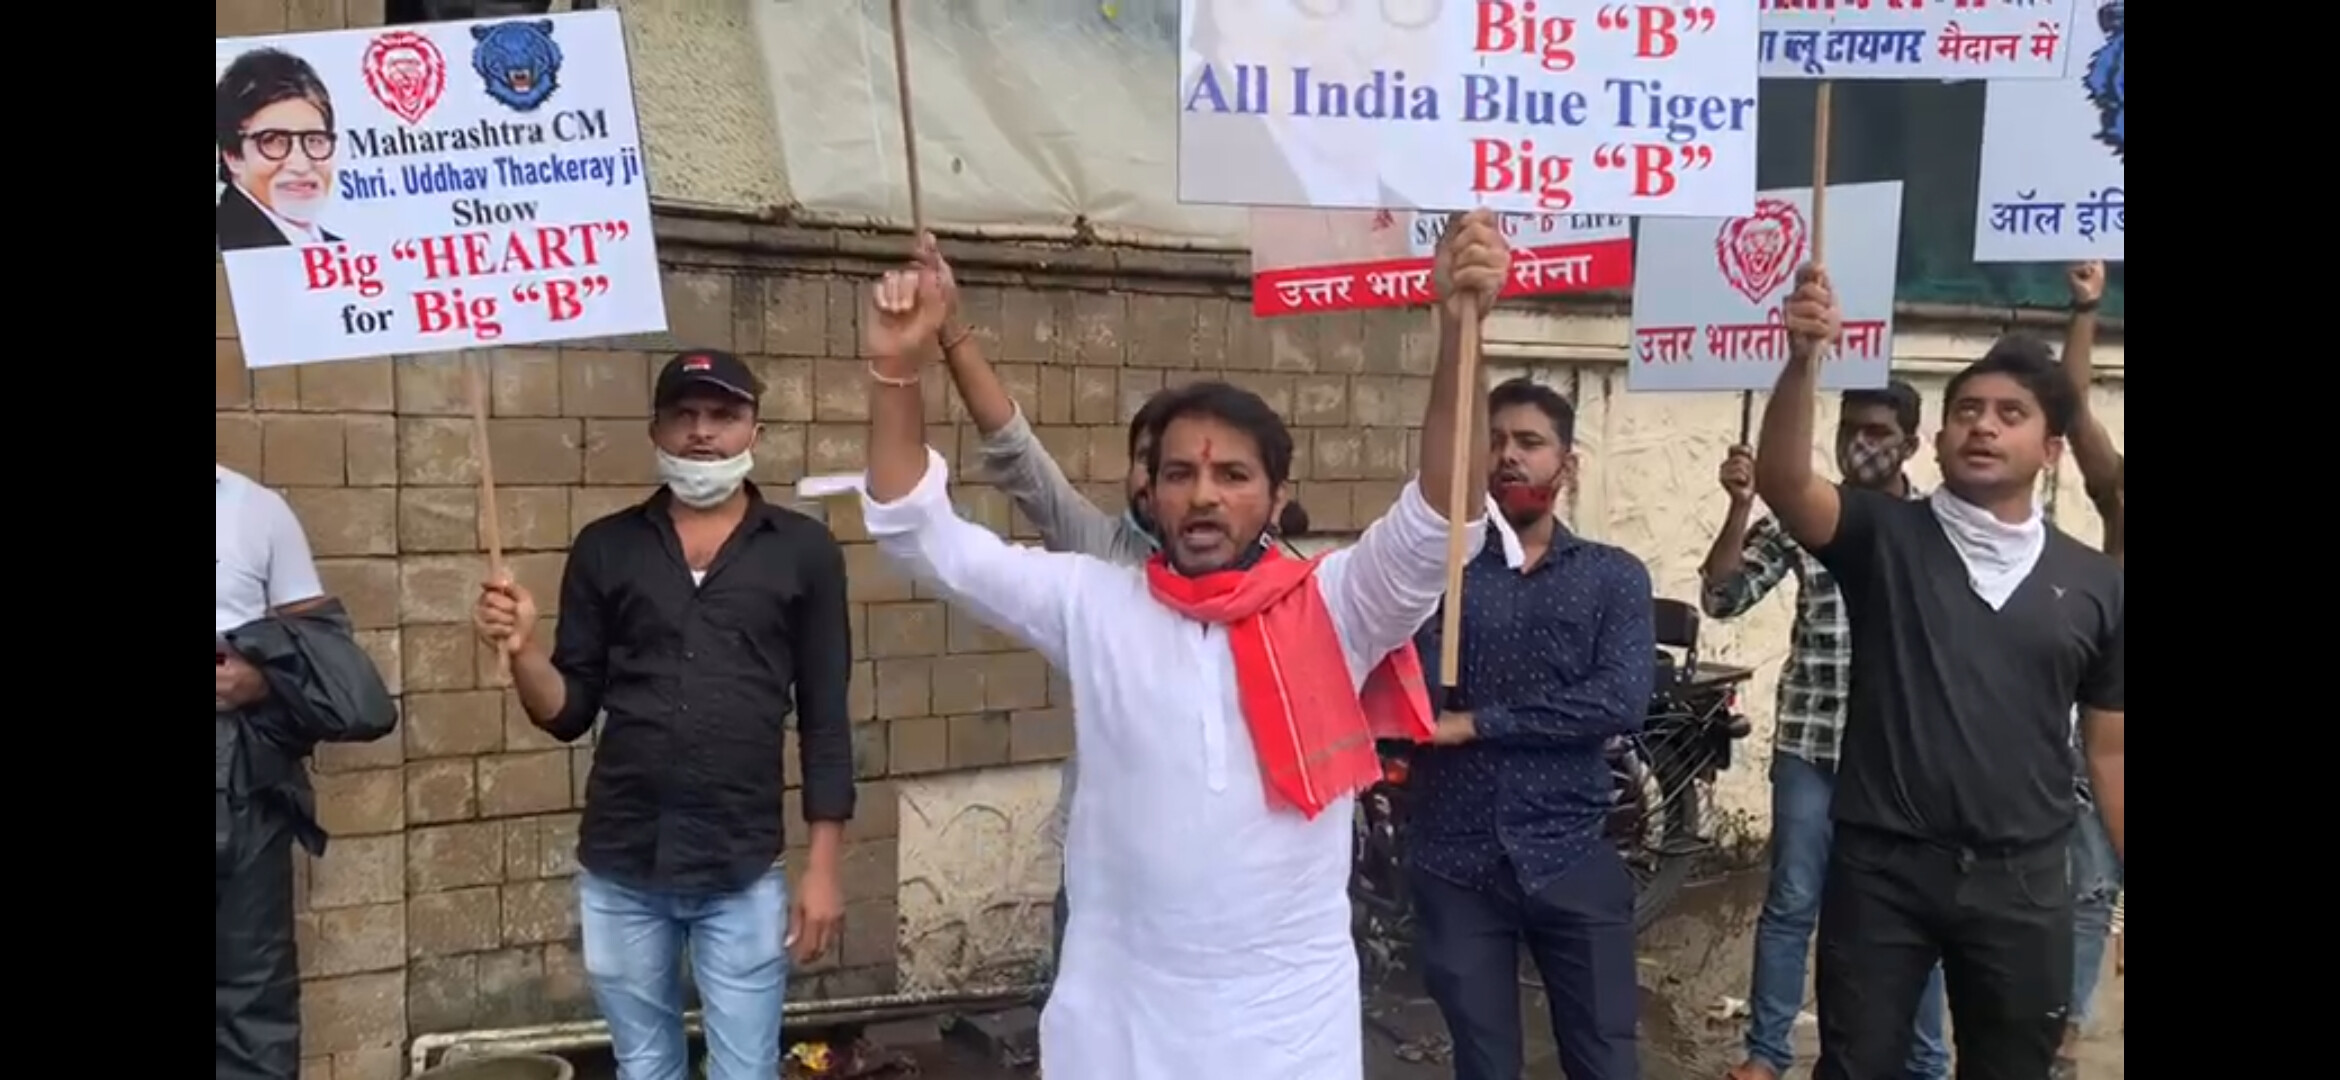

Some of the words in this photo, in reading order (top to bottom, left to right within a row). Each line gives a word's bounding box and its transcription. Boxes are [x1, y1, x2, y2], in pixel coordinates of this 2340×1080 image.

[1472, 0, 1576, 70] Big
[1597, 2, 1716, 59] “B”
[1784, 30, 1825, 74] ब्लू
[1825, 30, 1926, 63] टायगर
[1938, 20, 2022, 63] मैदान
[2031, 22, 2060, 63] में
[1185, 63, 1268, 113] All
[1292, 68, 1440, 122] India
[1460, 72, 1588, 126] Blue
[1604, 78, 1755, 142] Tiger
[346, 122, 545, 159] Maharashtra
[552, 109, 609, 143] CM
[339, 169, 397, 200] Shri.
[406, 158, 489, 196] Uddhav
[498, 149, 616, 188] Thackeray
[618, 147, 639, 186] ji
[1470, 139, 1574, 210] Big
[1593, 145, 1713, 197] “B”
[453, 200, 538, 227] Show
[1989, 189, 2066, 235] ऑल
[301, 243, 384, 298] Big
[391, 220, 630, 280] “HEART”
[1276, 276, 1354, 308] उत्तर
[1513, 249, 1593, 289] सेना
[341, 304, 394, 335] for
[412, 287, 503, 340] Big
[512, 275, 610, 321] “B”
[1636, 326, 1696, 362] उत्तर
[1706, 307, 1786, 360] भारती
